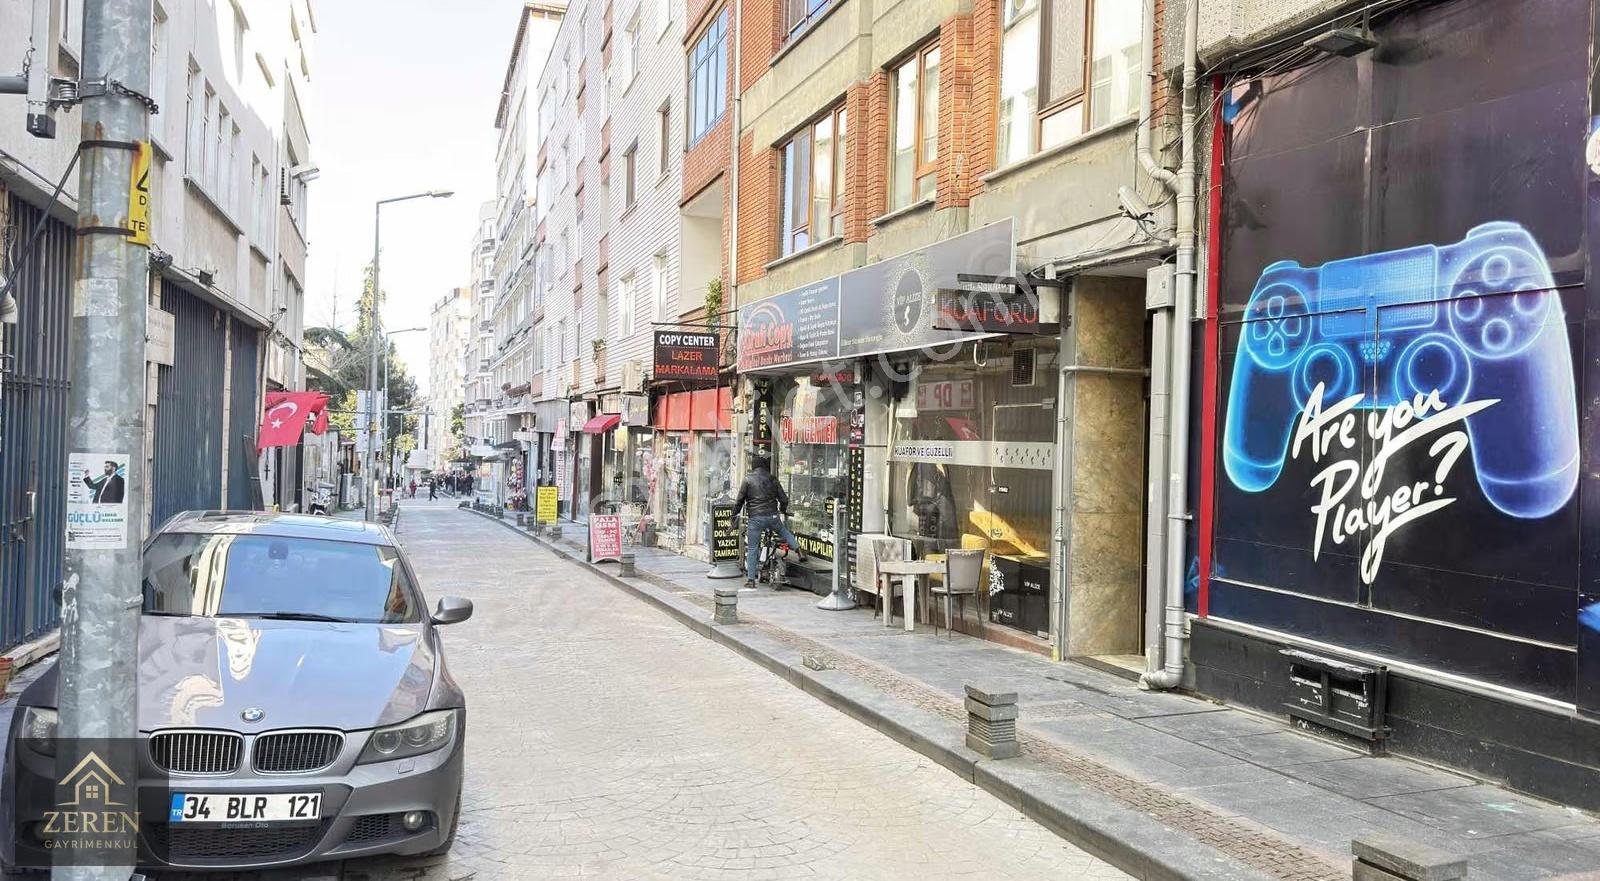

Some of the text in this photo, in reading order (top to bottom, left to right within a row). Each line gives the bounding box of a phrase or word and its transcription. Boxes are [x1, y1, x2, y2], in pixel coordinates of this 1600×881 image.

[659, 334, 715, 347] COPY CENTER
[767, 320, 793, 350] Copy
[671, 350, 703, 361] LAZER
[655, 365, 717, 376] MARKALAMA
[759, 401, 767, 439] BASKI
[1292, 381, 1502, 500] Are you
[68, 510, 101, 525] GÜÇLÜ
[1310, 430, 1469, 585] Player?
[717, 539, 737, 548] YAZICI
[809, 538, 833, 559] YAPILIR
[172, 795, 320, 819] TR 34 BLR 121
